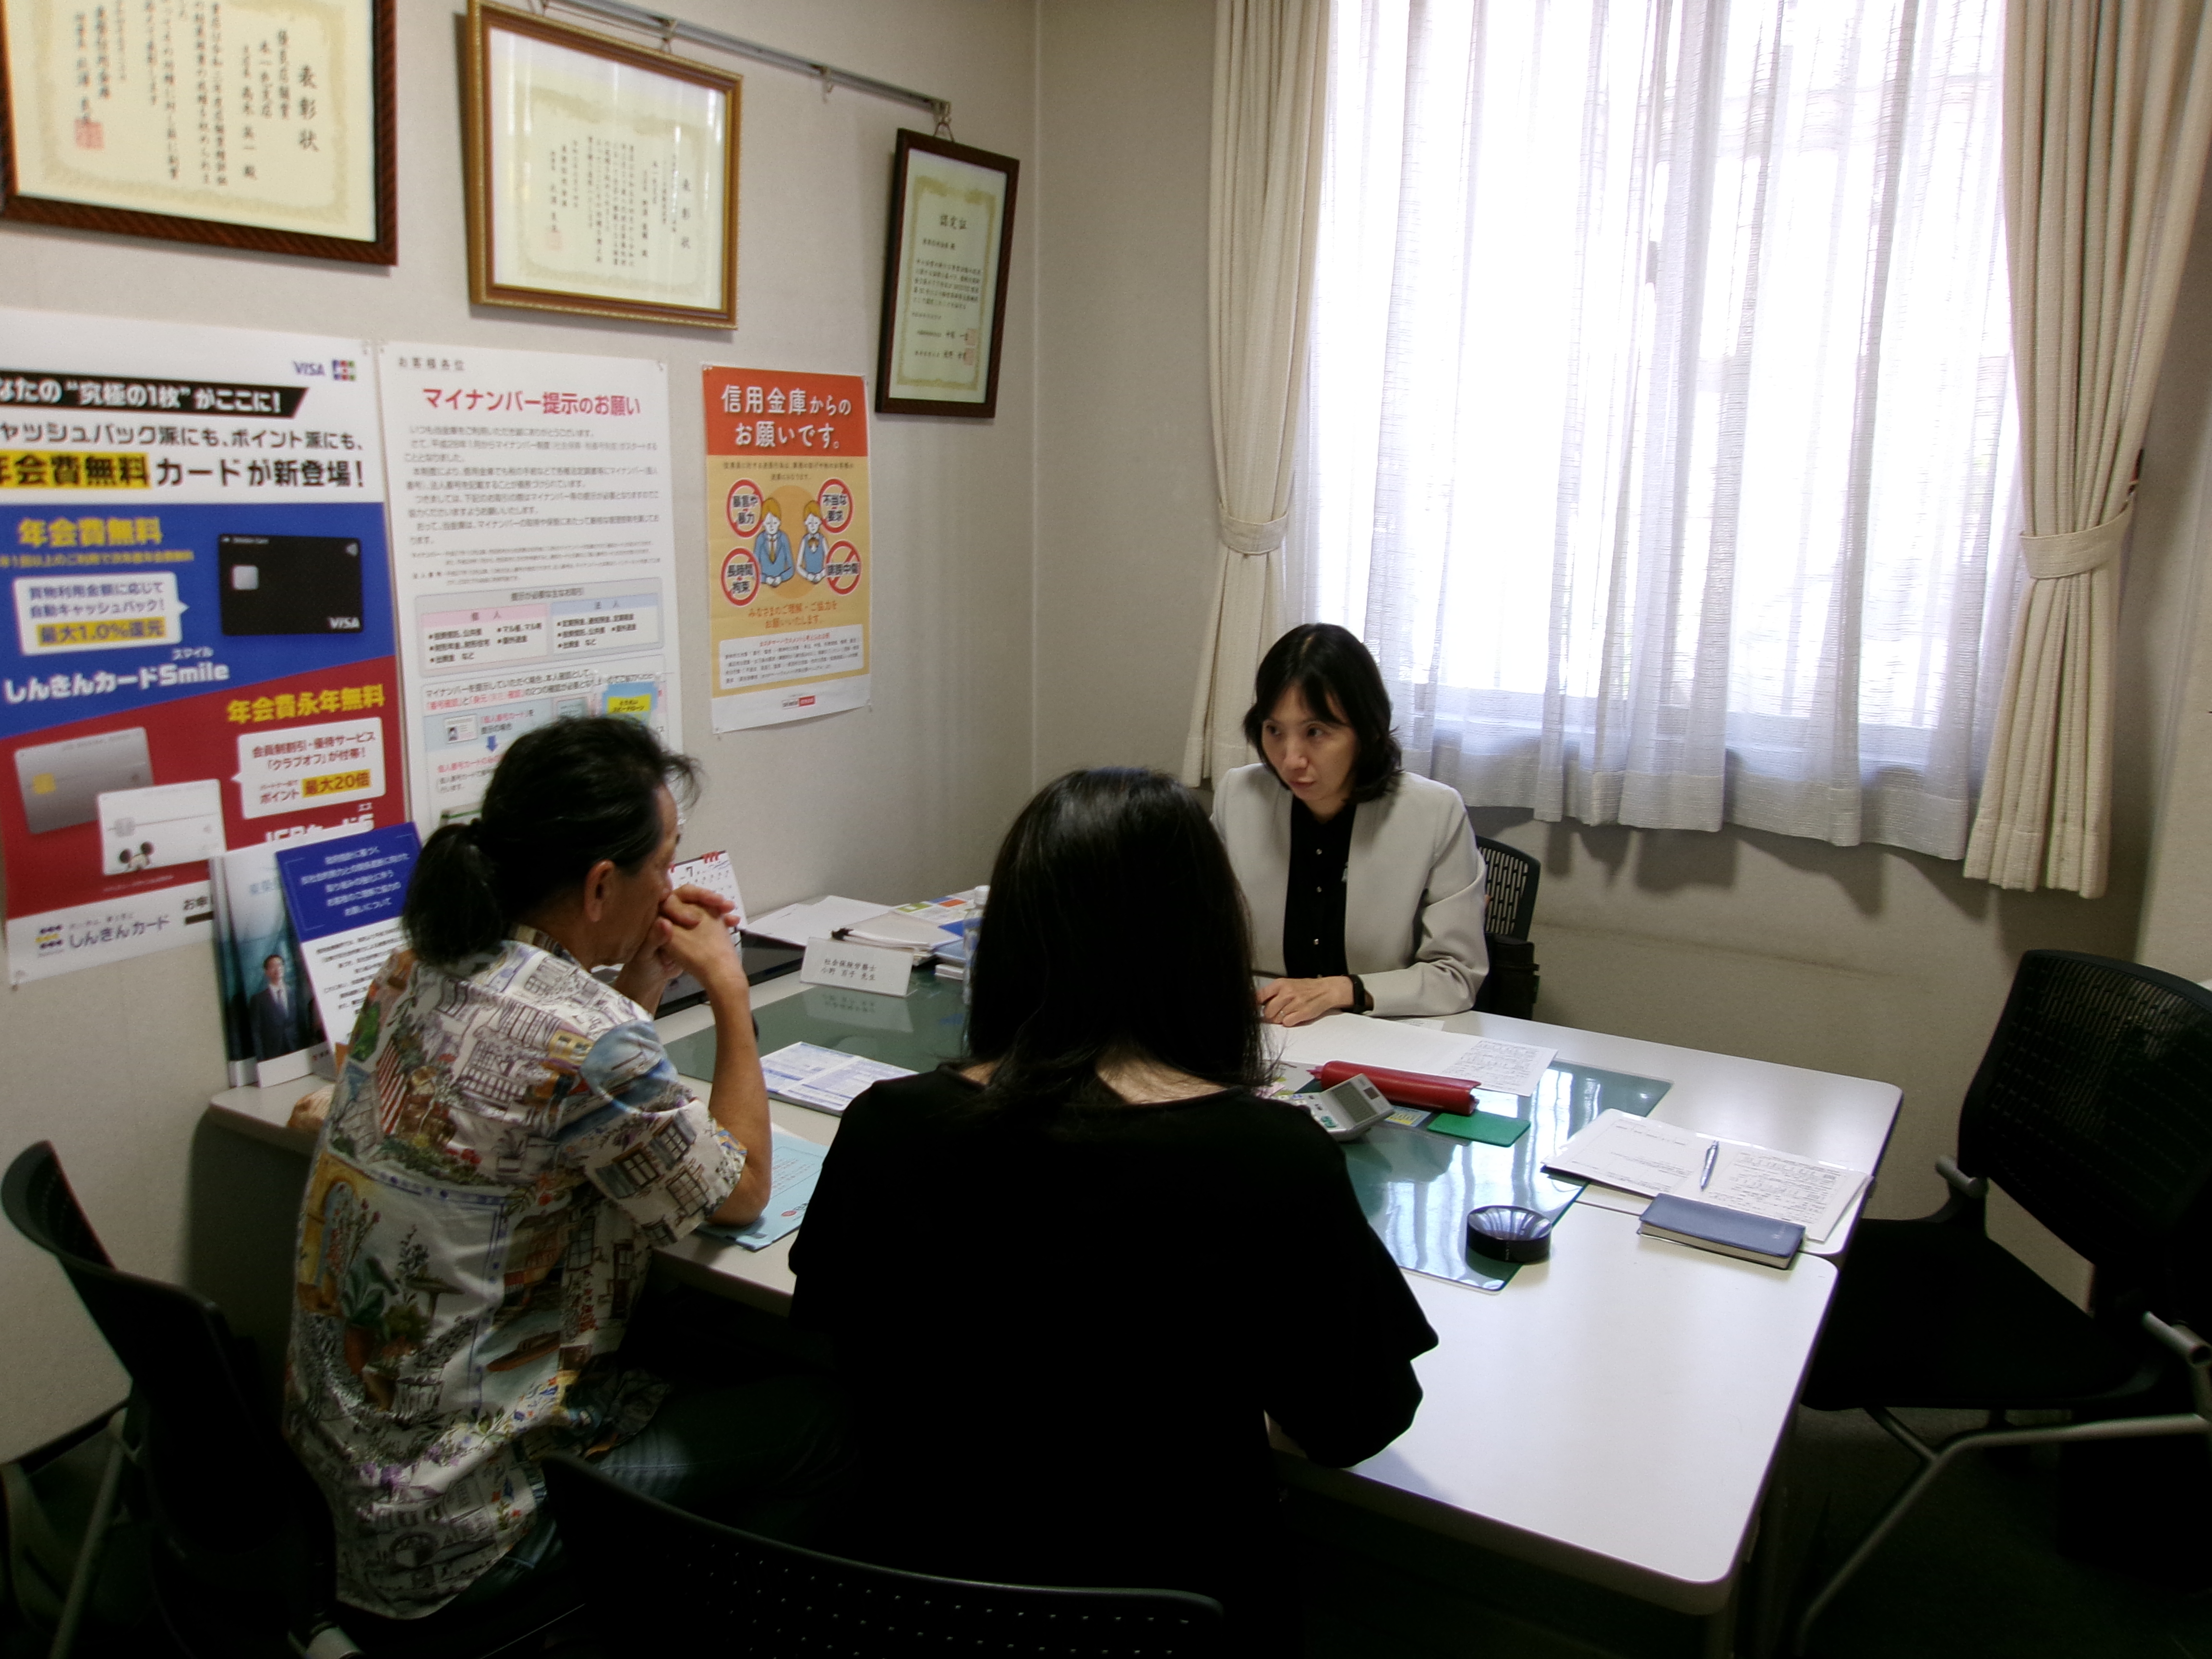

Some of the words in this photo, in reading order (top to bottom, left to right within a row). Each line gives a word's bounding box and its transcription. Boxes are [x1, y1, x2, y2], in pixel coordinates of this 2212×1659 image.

[298, 64, 319, 152] 表彰状
[294, 361, 325, 376] VISA
[399, 358, 464, 371] お客様各位
[422, 388, 640, 416] マイナンバー提示のお願い
[721, 384, 853, 416] 信用金庫からの
[735, 420, 841, 450] お願いです。
[822, 494, 848, 506] 不当な
[738, 511, 756, 525] 暴力
[18, 517, 162, 548] 年会費無料
[728, 564, 755, 577] 長時間
[328, 616, 360, 629] VISA
[4, 661, 230, 704] しんきんカードSmile
[227, 684, 385, 724] 年会費永年無料
[259, 789, 300, 805] ポイント
[304, 771, 370, 796] 最大20倍
[70, 914, 170, 949] しんきんカード
[825, 959, 876, 972] 社会保険労務士
[862, 973, 875, 981] 先生
